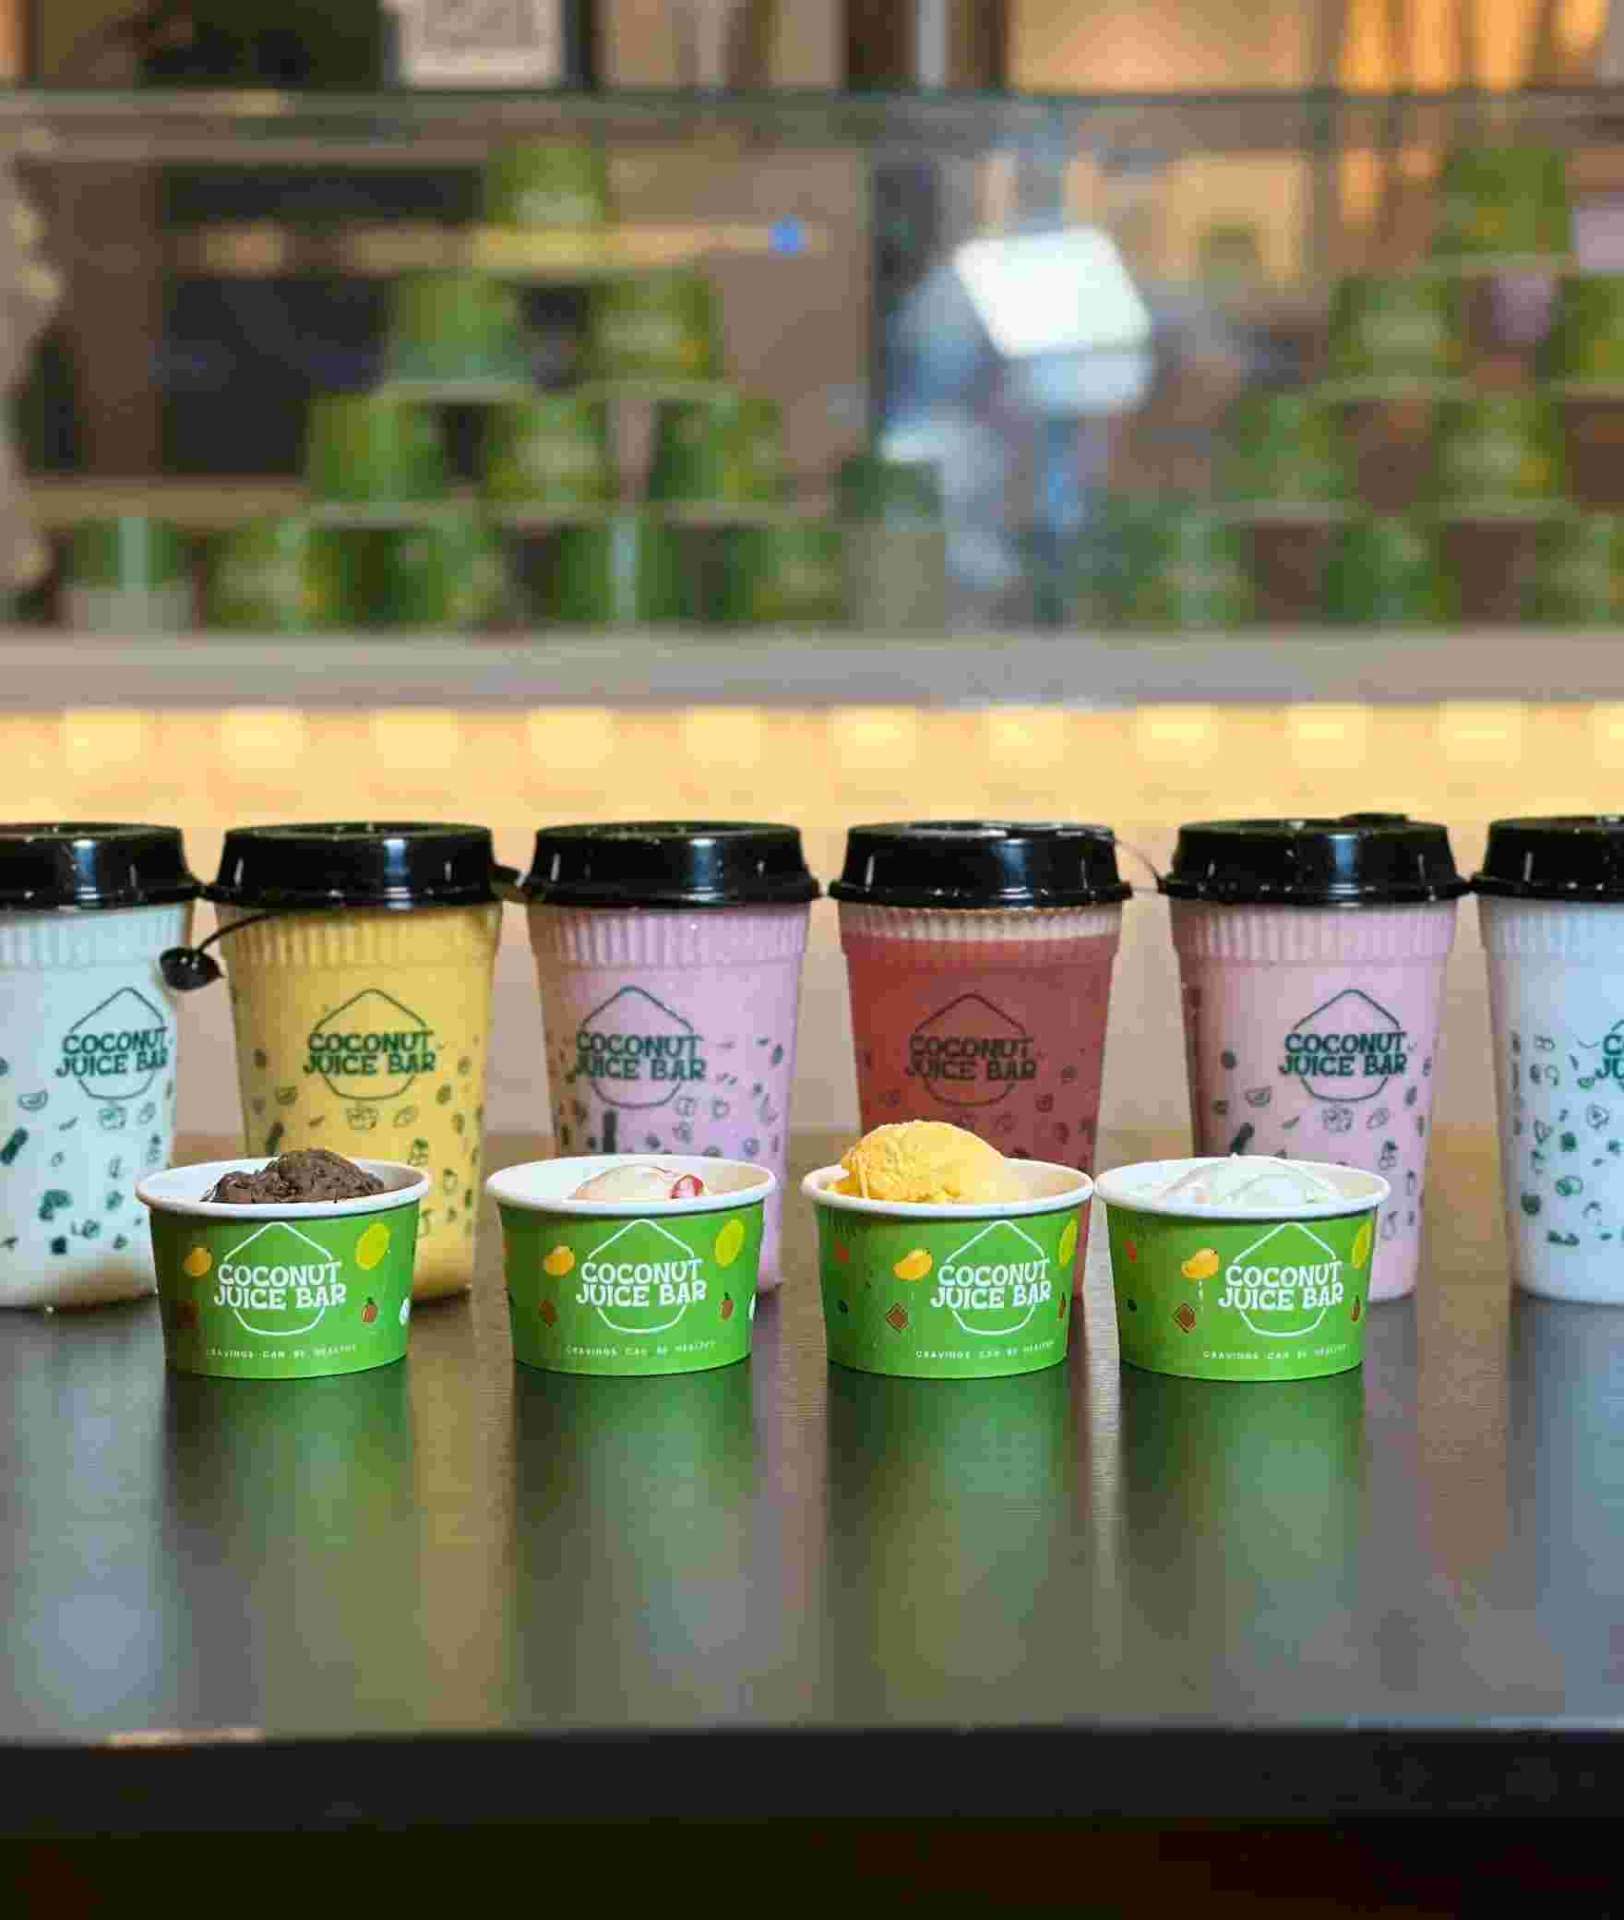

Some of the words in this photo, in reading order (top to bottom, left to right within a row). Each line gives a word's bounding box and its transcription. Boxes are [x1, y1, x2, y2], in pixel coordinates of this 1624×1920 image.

[62, 1026, 168, 1055] COCONUT
[308, 1029, 434, 1053] COCONUT
[576, 1031, 704, 1057] COCONUT
[910, 1034, 1034, 1057] COCONUT
[1285, 1031, 1407, 1055] COCONUT
[56, 1054, 128, 1077] JUICE
[303, 1053, 377, 1075] JUICE
[388, 1049, 436, 1074] BAR
[650, 1057, 706, 1079] BAR
[904, 1057, 976, 1079] JUICE
[987, 1059, 1036, 1080] BAR
[1278, 1055, 1355, 1076] JUICE
[1364, 1053, 1407, 1076] BAR
[217, 1261, 343, 1288] COCONUT
[580, 1258, 704, 1285] COCONUT
[938, 1258, 1051, 1288] COCONUT
[1225, 1260, 1343, 1288] COCONUT
[213, 1284, 288, 1310] JUICE
[295, 1283, 347, 1309] BAR
[575, 1282, 650, 1307] JUICE
[658, 1279, 708, 1306] BAR
[930, 1285, 1005, 1310] JUICE
[1012, 1280, 1052, 1307] BAR
[1218, 1286, 1295, 1311] JUICE
[1302, 1281, 1345, 1310] BAR
[262, 1351, 286, 1359] CAN
[1267, 1351, 1289, 1360] CAN
